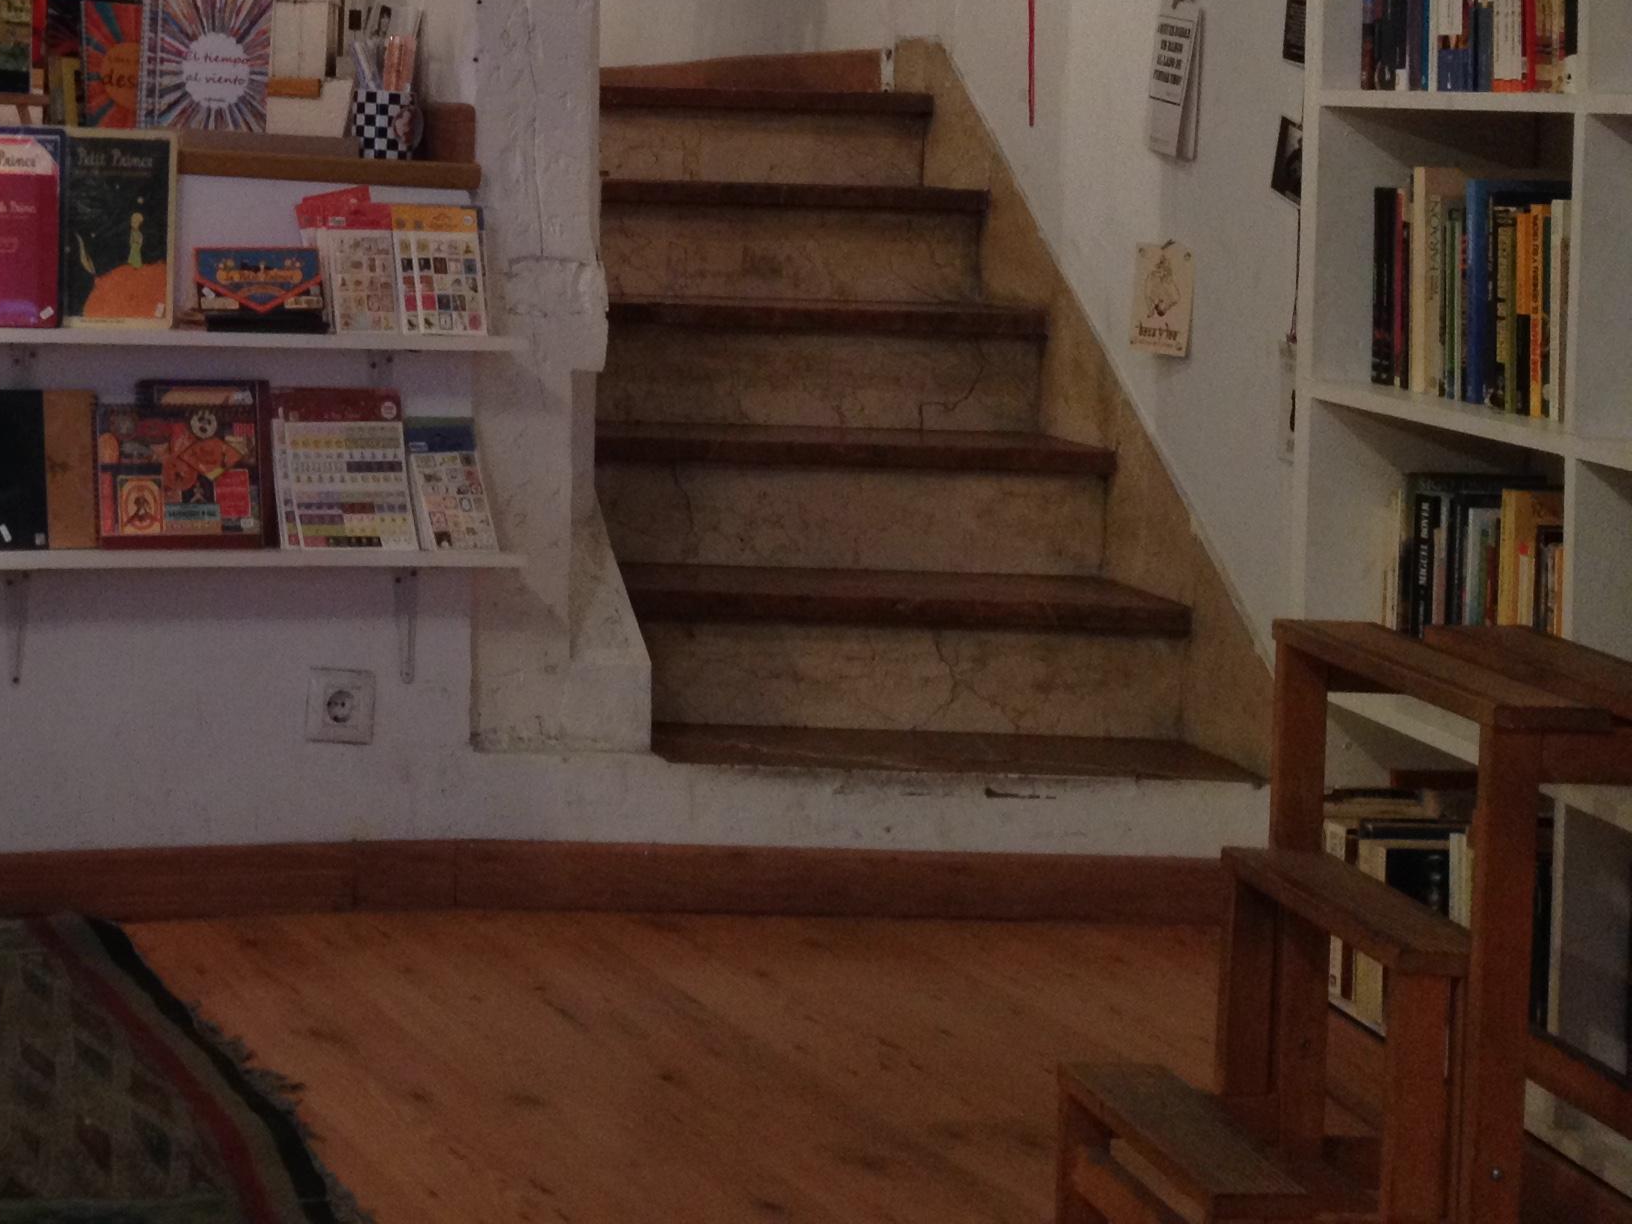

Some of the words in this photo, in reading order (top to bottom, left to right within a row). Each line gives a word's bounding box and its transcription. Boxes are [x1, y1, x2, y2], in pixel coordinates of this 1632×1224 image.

[111, 148, 153, 168] Prince
[1418, 502, 1429, 539] BOYER
[1418, 544, 1429, 586] MIGUEL
